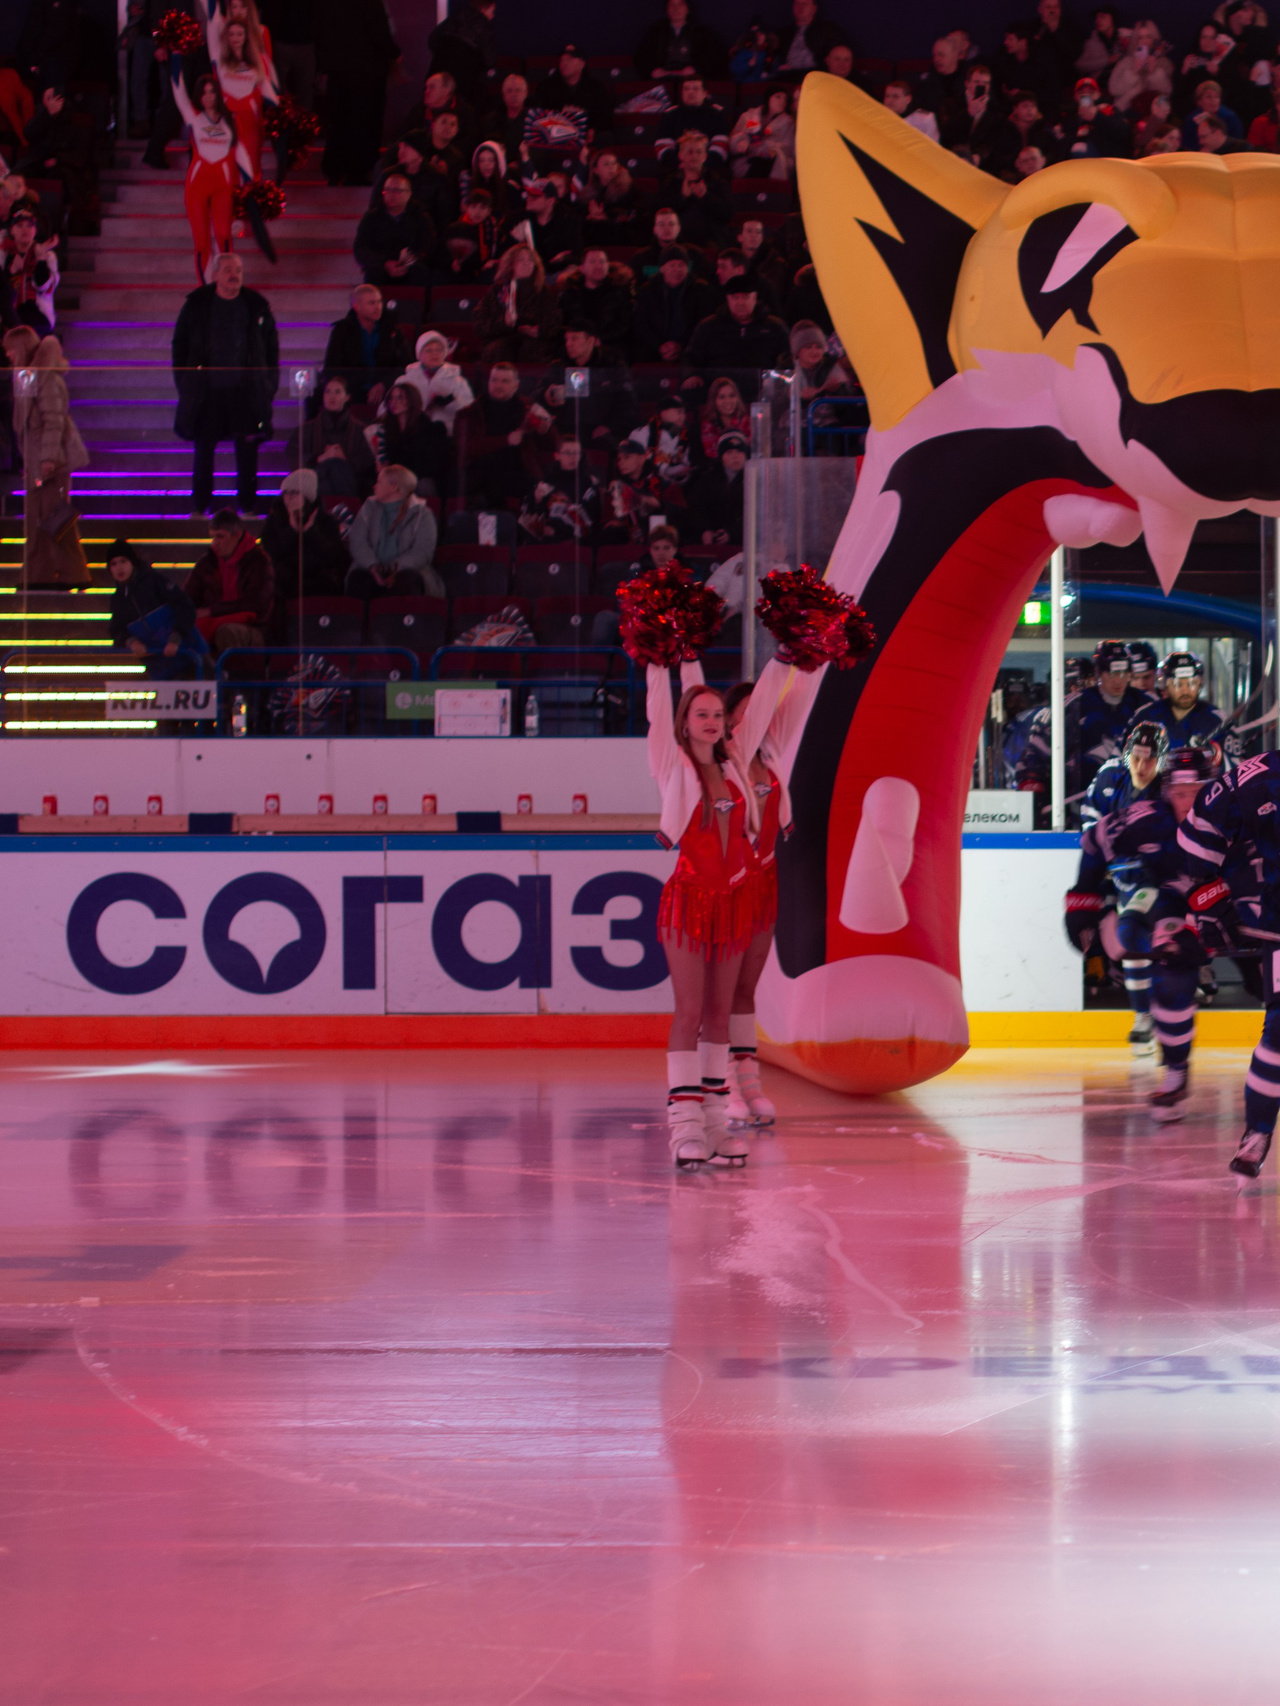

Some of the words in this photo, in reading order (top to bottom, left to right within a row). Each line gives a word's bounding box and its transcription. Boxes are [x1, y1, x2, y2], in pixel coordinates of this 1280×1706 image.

[111, 689, 211, 711] KHL.RU
[1204, 781, 1224, 807] 9
[964, 813, 1020, 823] елеком
[1197, 882, 1229, 906] BAU
[66, 871, 675, 995] согаз
